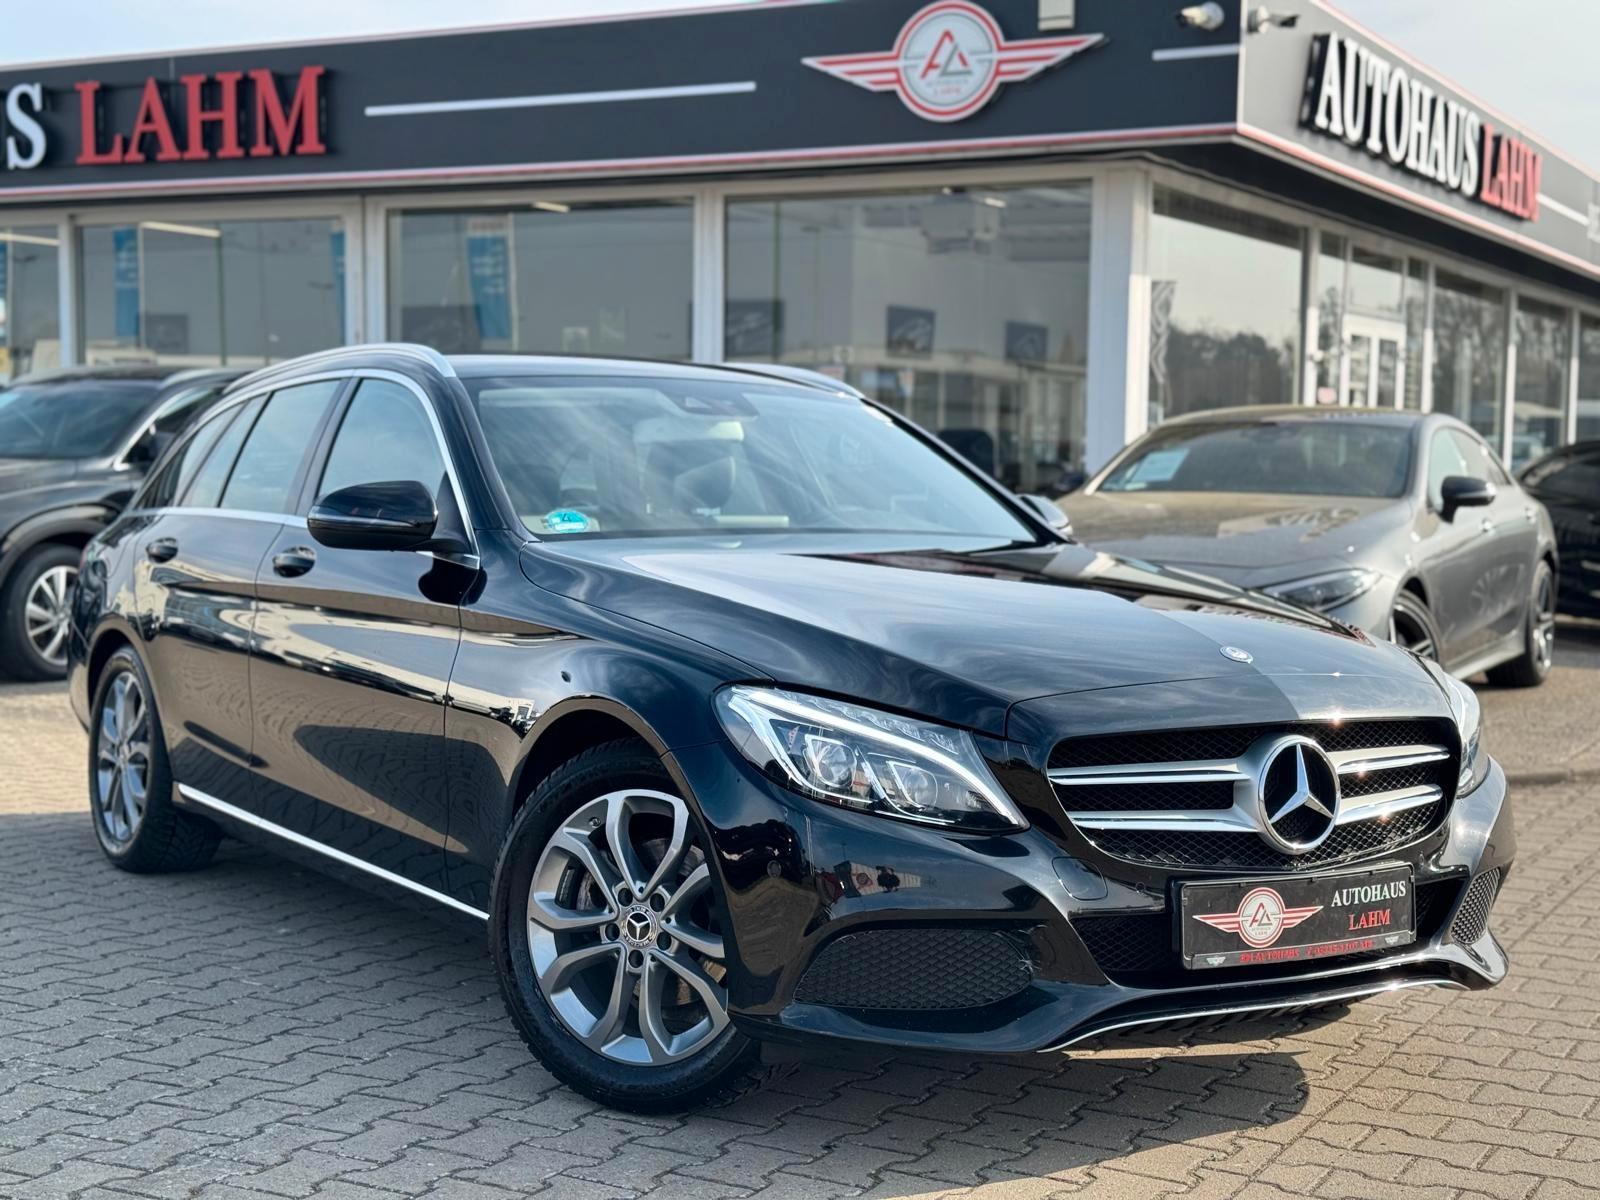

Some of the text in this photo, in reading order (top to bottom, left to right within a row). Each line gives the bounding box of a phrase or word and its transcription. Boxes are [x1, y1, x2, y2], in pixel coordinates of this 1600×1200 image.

[74, 66, 326, 165] LAHM
[1315, 31, 1543, 222] AUTOHAUS LAHM
[1331, 881, 1406, 907] AUTOHAUS
[1348, 908, 1391, 931] LAHM
